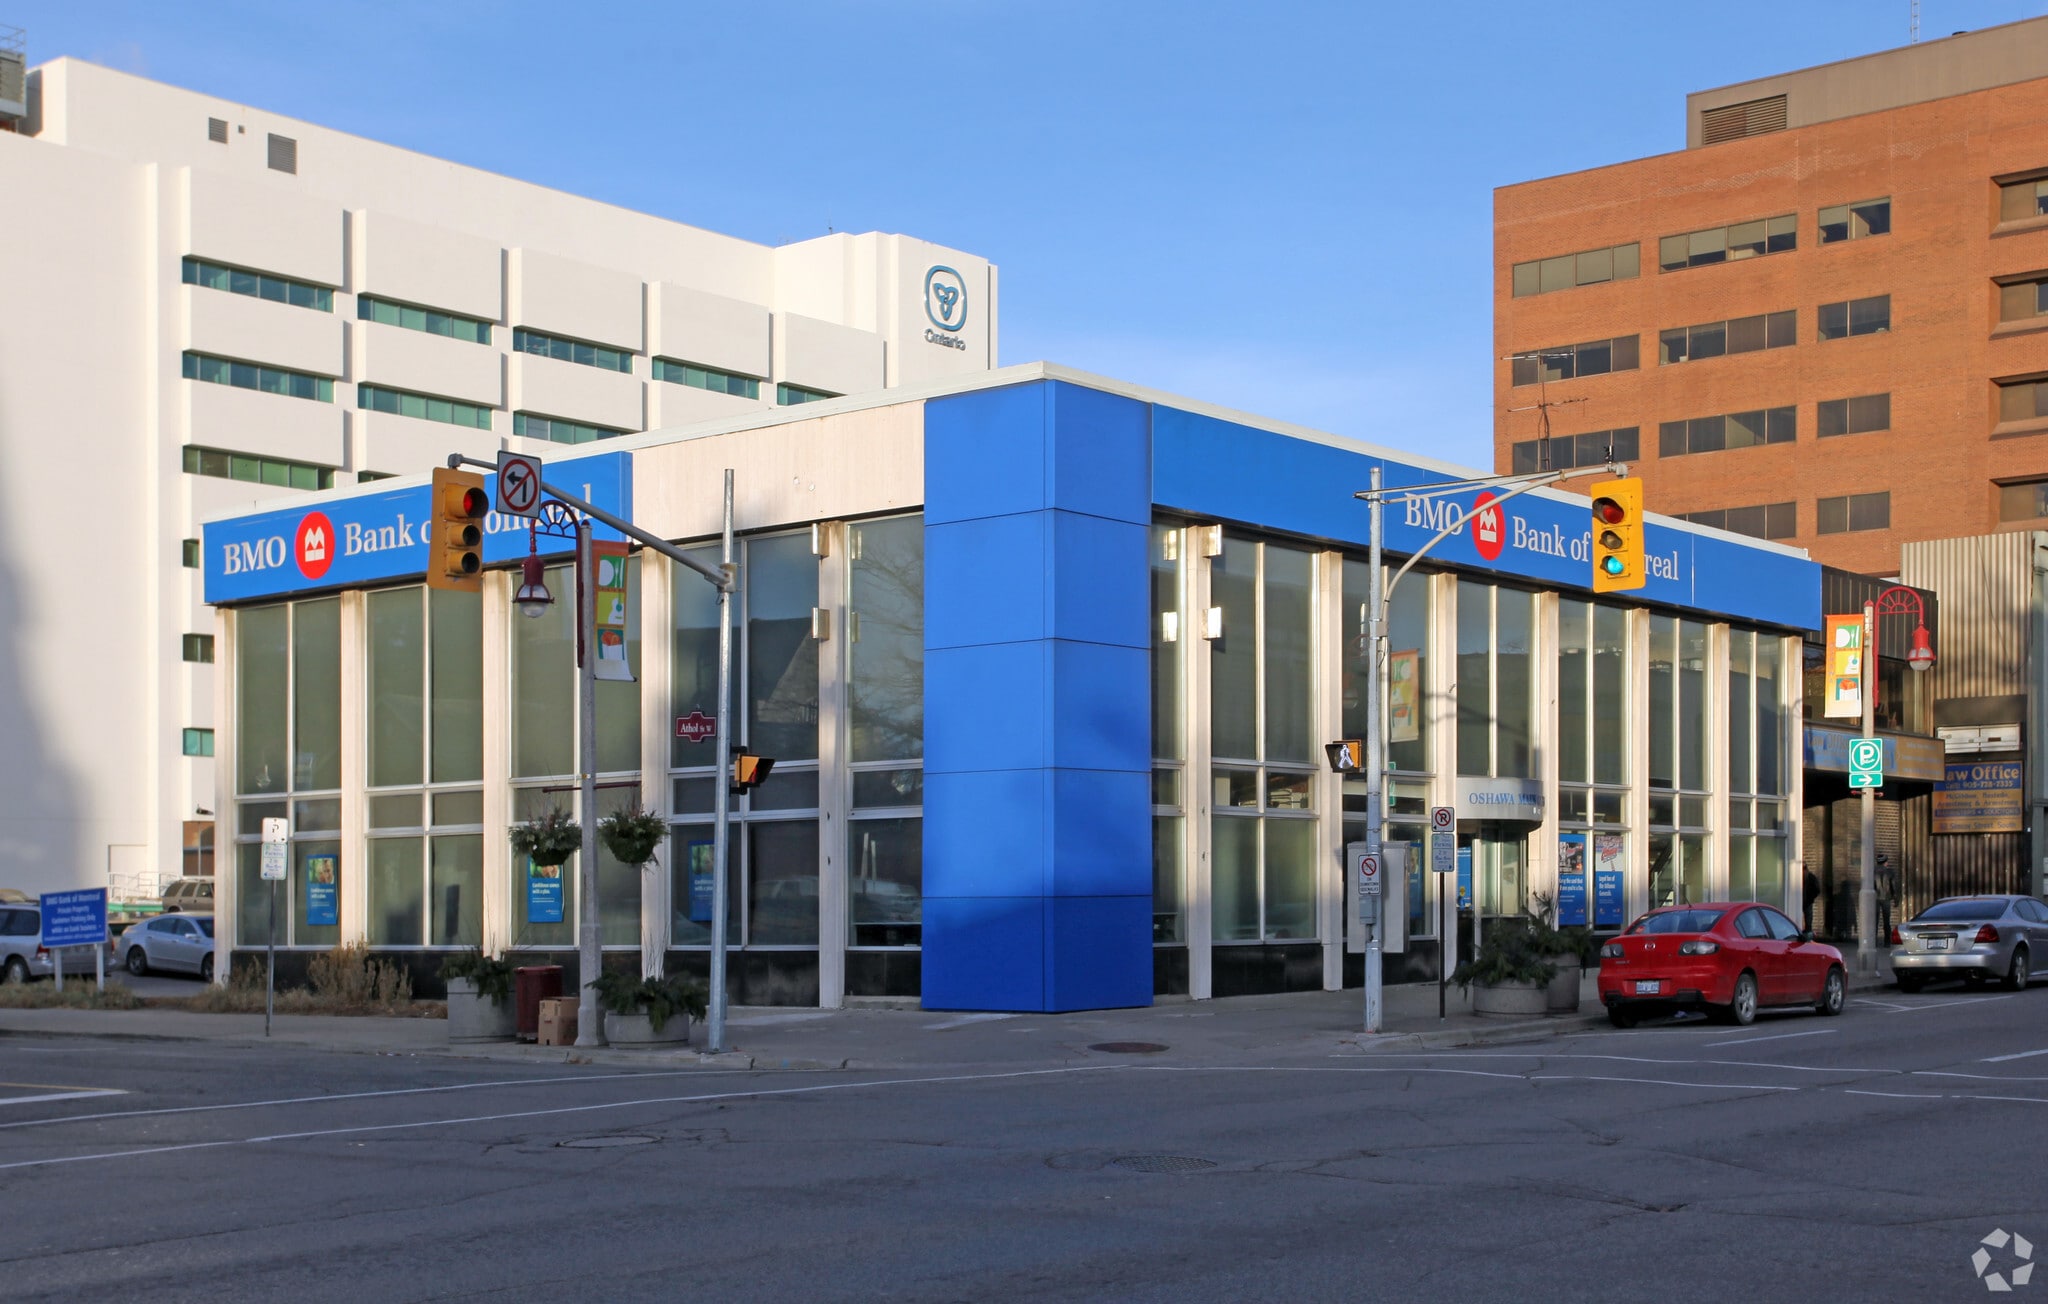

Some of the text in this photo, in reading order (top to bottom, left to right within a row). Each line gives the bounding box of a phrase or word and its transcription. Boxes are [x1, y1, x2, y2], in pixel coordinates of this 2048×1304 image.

[923, 328, 966, 351] Ontario
[223, 536, 286, 575] BMO
[343, 514, 415, 557] Bank
[1404, 493, 1680, 580] BMO Bank of real
[680, 722, 699, 733] Athol
[1946, 770, 1968, 781] aw
[1971, 765, 2020, 780] Office
[1469, 793, 1515, 805] OSHAWA
